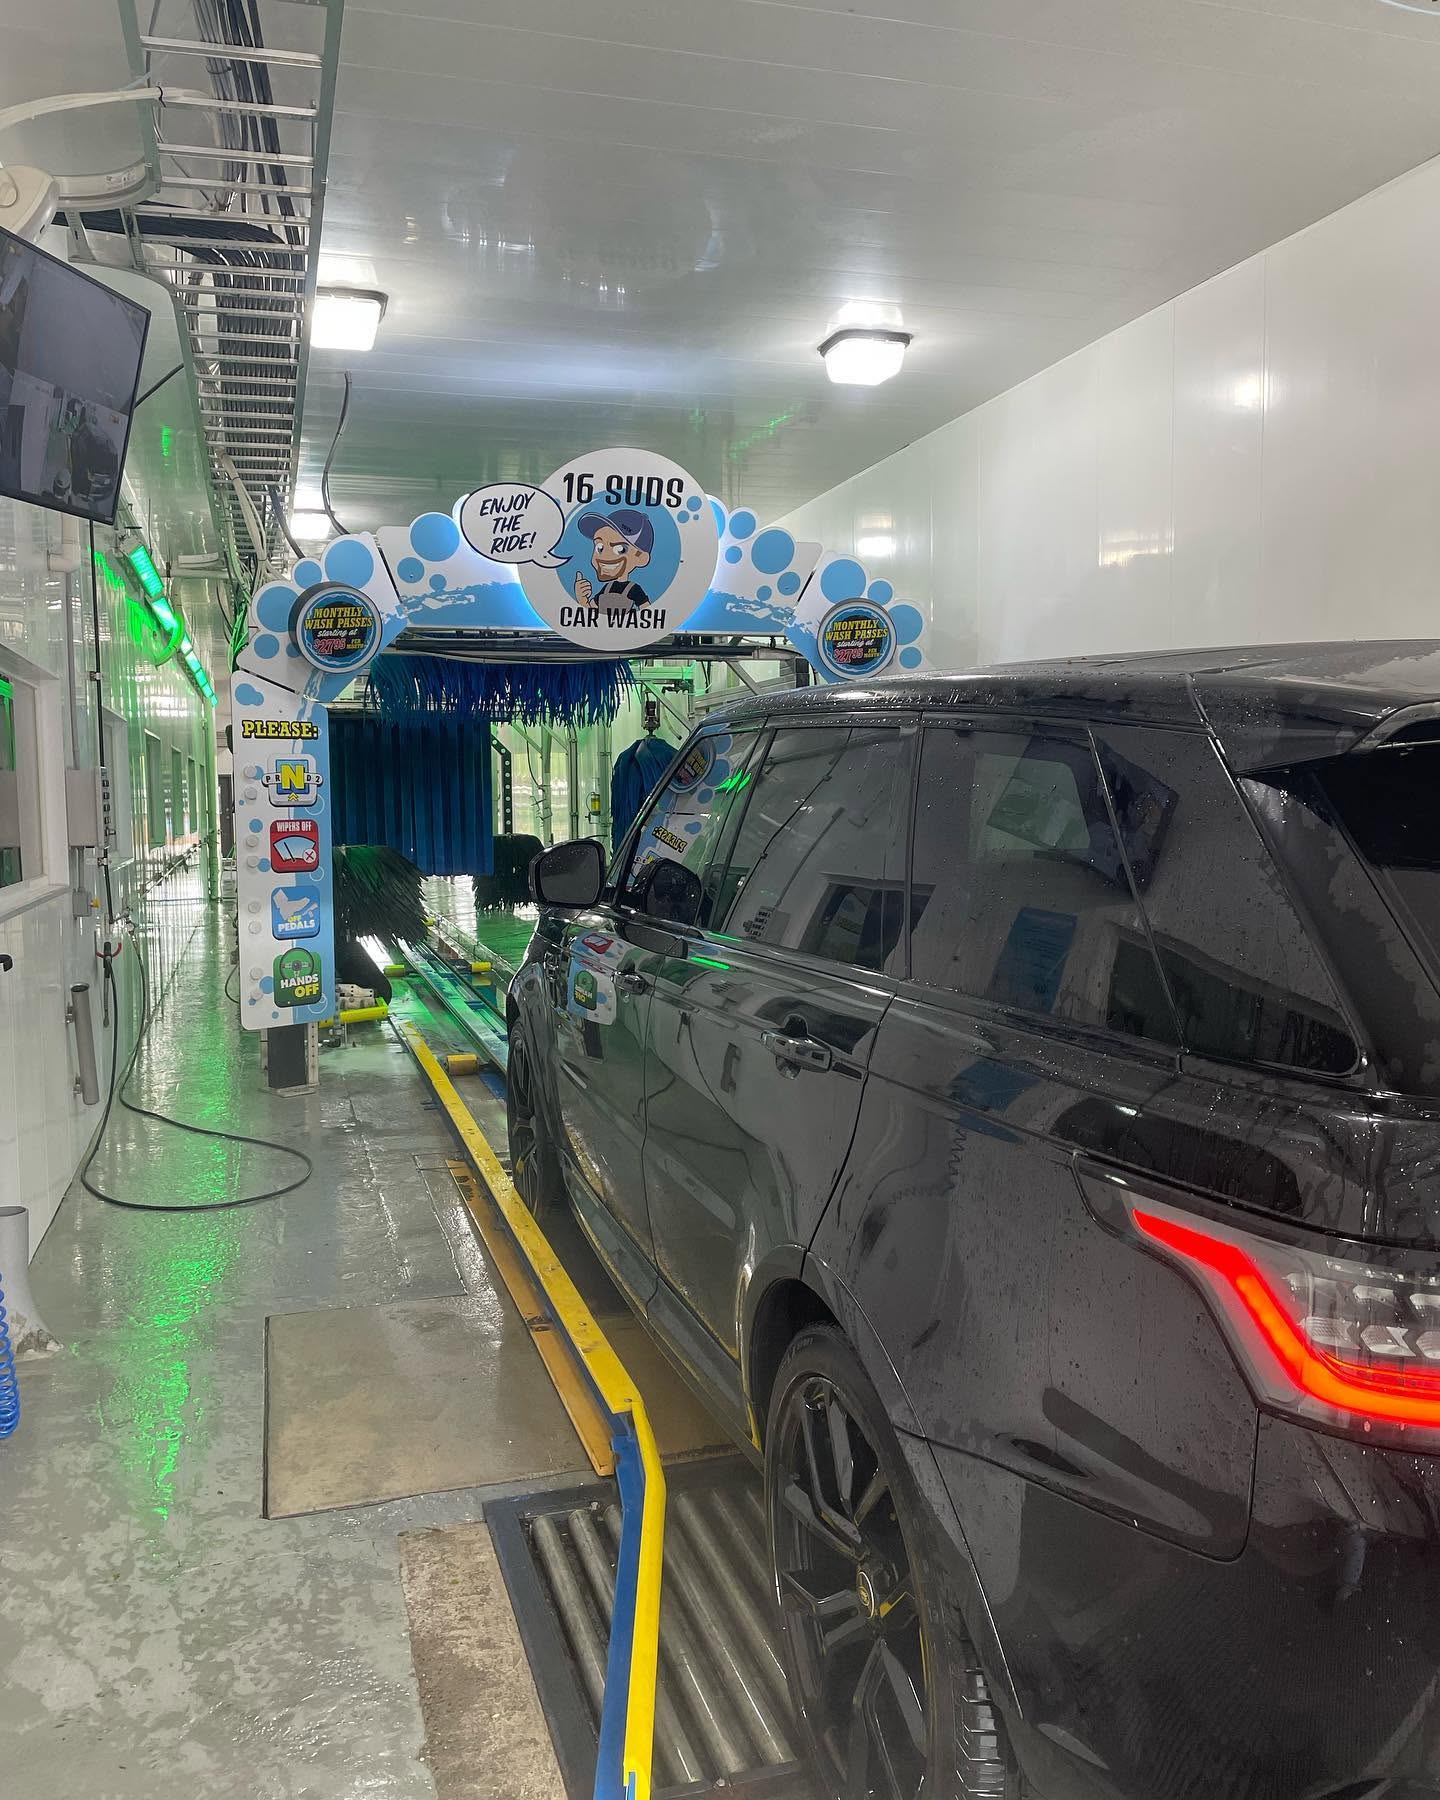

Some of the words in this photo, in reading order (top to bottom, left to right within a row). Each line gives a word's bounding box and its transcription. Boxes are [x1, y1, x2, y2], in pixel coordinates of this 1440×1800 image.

[563, 472, 594, 504] 16
[605, 474, 684, 508] SUDS
[479, 491, 536, 517] ENJOY
[492, 513, 525, 534] THE
[490, 531, 537, 554] RIDE!
[314, 607, 363, 618] MONTHLY
[560, 606, 599, 628] CAR
[606, 607, 666, 630] WASH
[305, 619, 333, 629] WASH
[336, 617, 373, 628] PASSES
[834, 620, 879, 631] MONTHLY
[317, 629, 348, 638] starting
[826, 631, 851, 641] WASH
[854, 628, 889, 639] PASSES
[836, 640, 865, 648] starting
[242, 720, 319, 740] PLEASE:
[280, 763, 305, 790] N
[276, 821, 300, 832] WIPERS
[301, 820, 312, 832] OFF
[277, 919, 315, 932] PEDALS
[280, 973, 319, 988] HANDS
[294, 983, 319, 998] OFF
